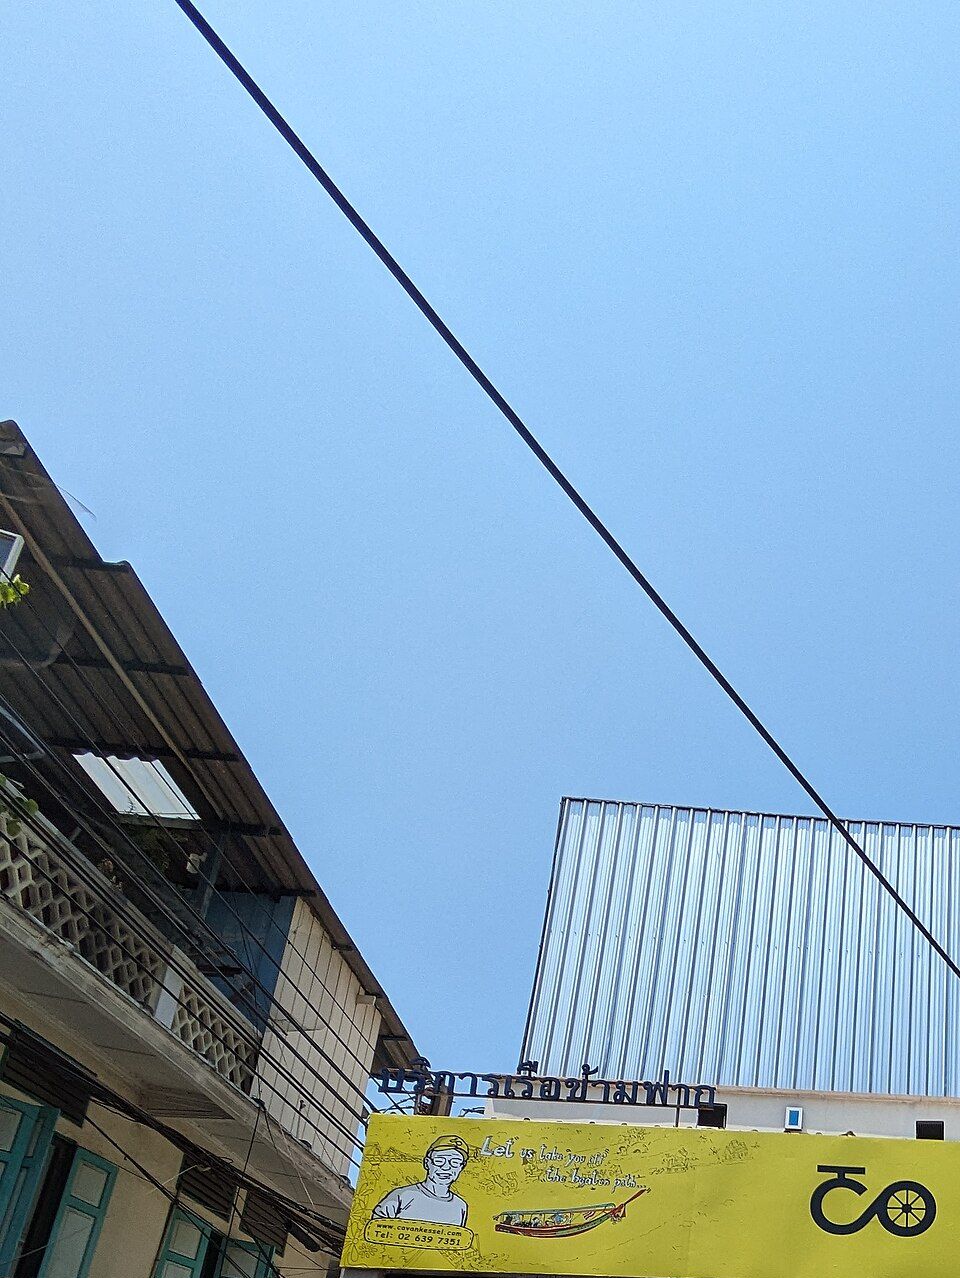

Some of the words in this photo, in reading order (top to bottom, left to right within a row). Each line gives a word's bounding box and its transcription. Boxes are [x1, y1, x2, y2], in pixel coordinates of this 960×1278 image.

[480, 1135, 514, 1158] Let
[520, 1147, 535, 1159] us
[539, 1144, 563, 1161] take
[568, 1153, 586, 1167] you
[545, 1167, 566, 1183] the
[571, 1168, 611, 1187] beaten
[375, 1230, 393, 1239] Tel:
[414, 1235, 433, 1243] 639
[438, 1237, 461, 1245] 7351
